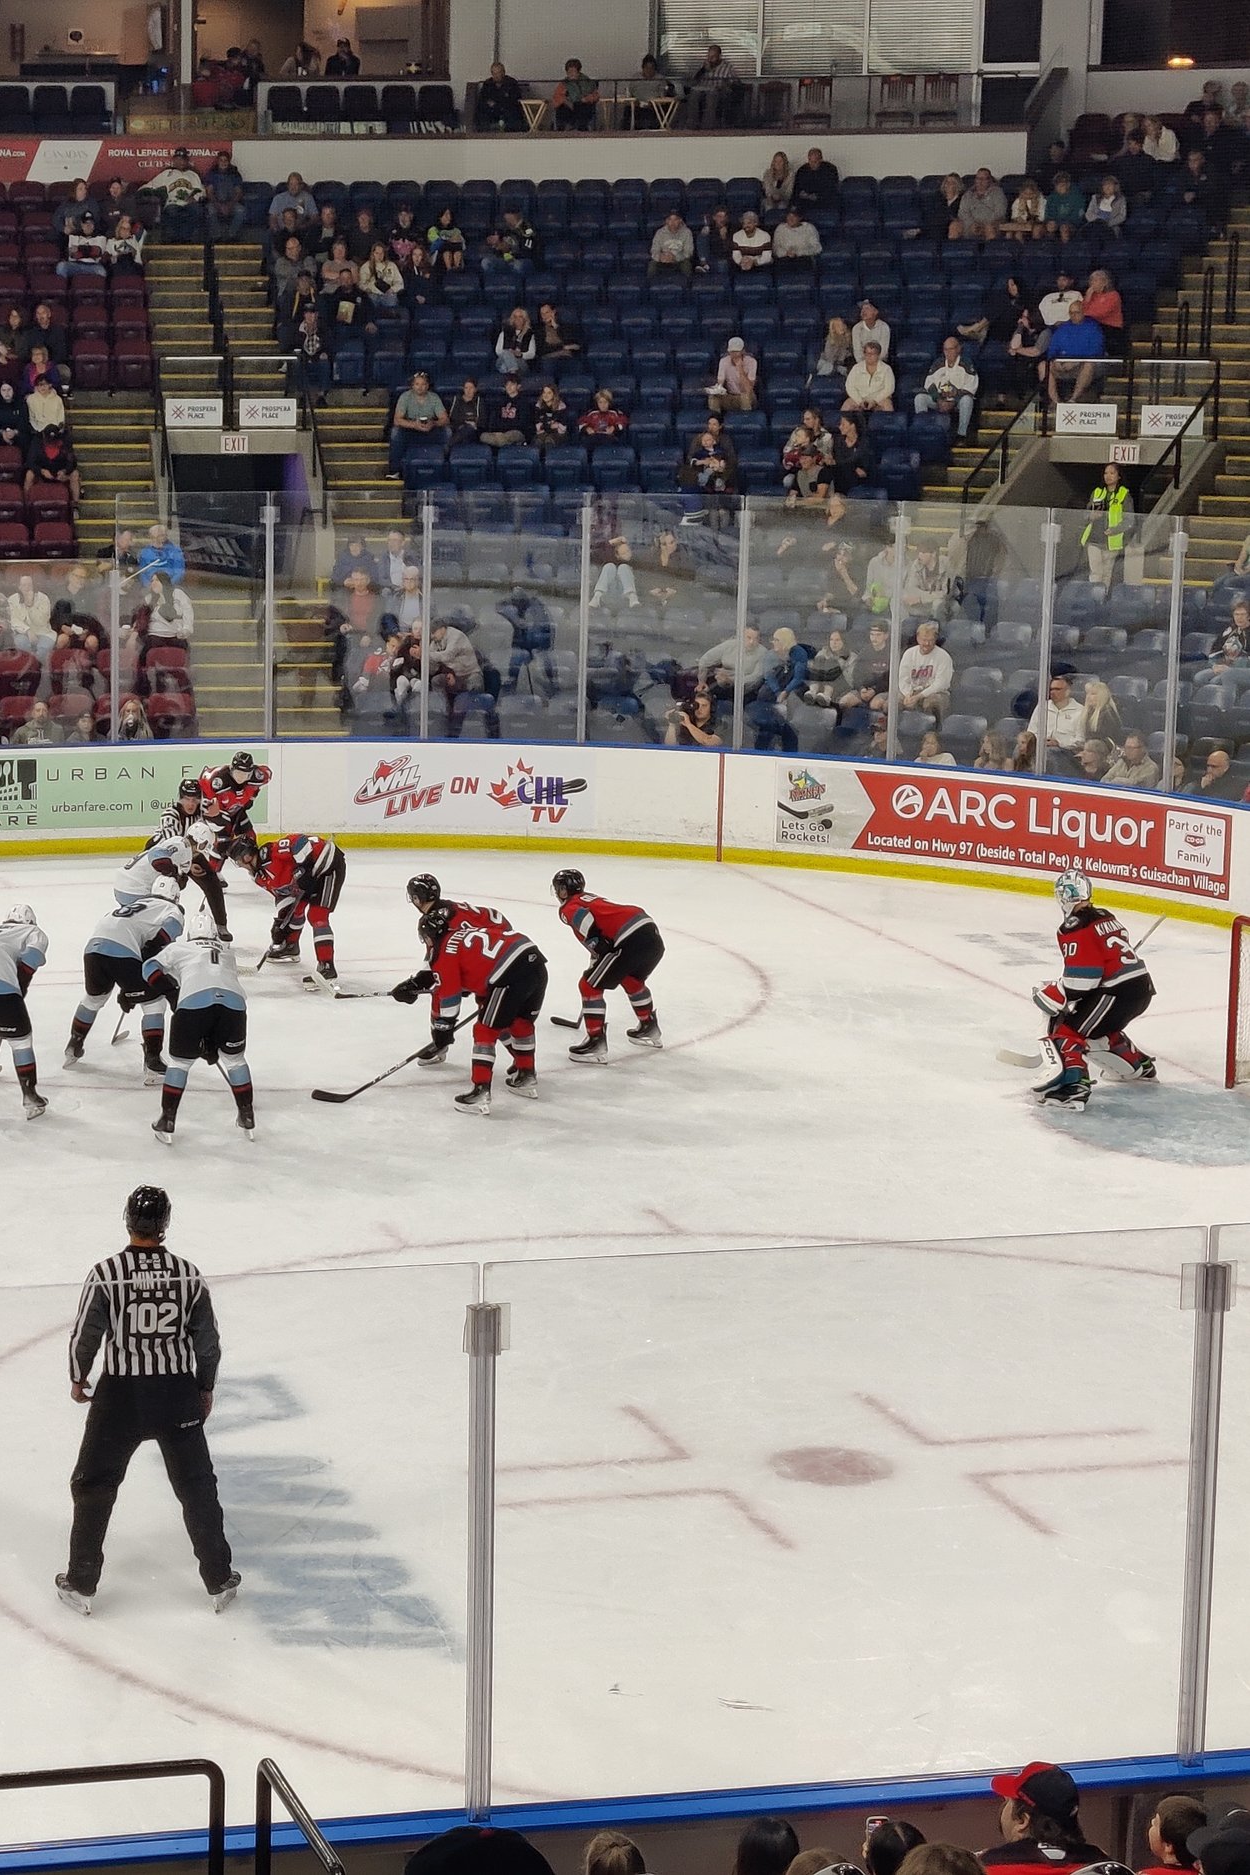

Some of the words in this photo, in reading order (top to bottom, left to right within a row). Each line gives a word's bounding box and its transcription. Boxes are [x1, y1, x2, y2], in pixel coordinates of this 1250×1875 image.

[108, 149, 134, 157] ROYAL
[224, 438, 246, 451] EXIT
[1114, 446, 1137, 462] EXIT
[46, 766, 155, 782] URBAN
[364, 764, 421, 797] WHL
[450, 776, 480, 794] ON
[517, 776, 568, 806] CHL
[52, 800, 133, 812] urbanfare.com
[384, 782, 446, 819] LIVE
[530, 806, 568, 824] TV
[924, 787, 1016, 830] ARC
[1028, 797, 1155, 849] Liquor
[782, 820, 805, 830] Lets
[808, 822, 824, 832] Go
[1168, 818, 1190, 832] Part
[1192, 823, 1204, 834] of
[1206, 825, 1223, 836] the
[782, 830, 830, 844] Rockets!
[867, 832, 912, 848] Located
[914, 838, 929, 850] on
[932, 839, 957, 857] Hwy
[958, 842, 973, 855] 97
[976, 844, 1016, 860] (beside
[1018, 848, 1046, 864] Total
[1048, 852, 1070, 870] Pet)
[1072, 858, 1083, 870] &
[1086, 857, 1138, 878] Kelowna's
[1140, 866, 1190, 887] Guisachan
[1192, 874, 1226, 896] Village
[1177, 850, 1212, 868] Family
[1043, 1040, 1058, 1065] CCM
[132, 1270, 172, 1290] MINTY
[126, 1302, 178, 1334] 102
